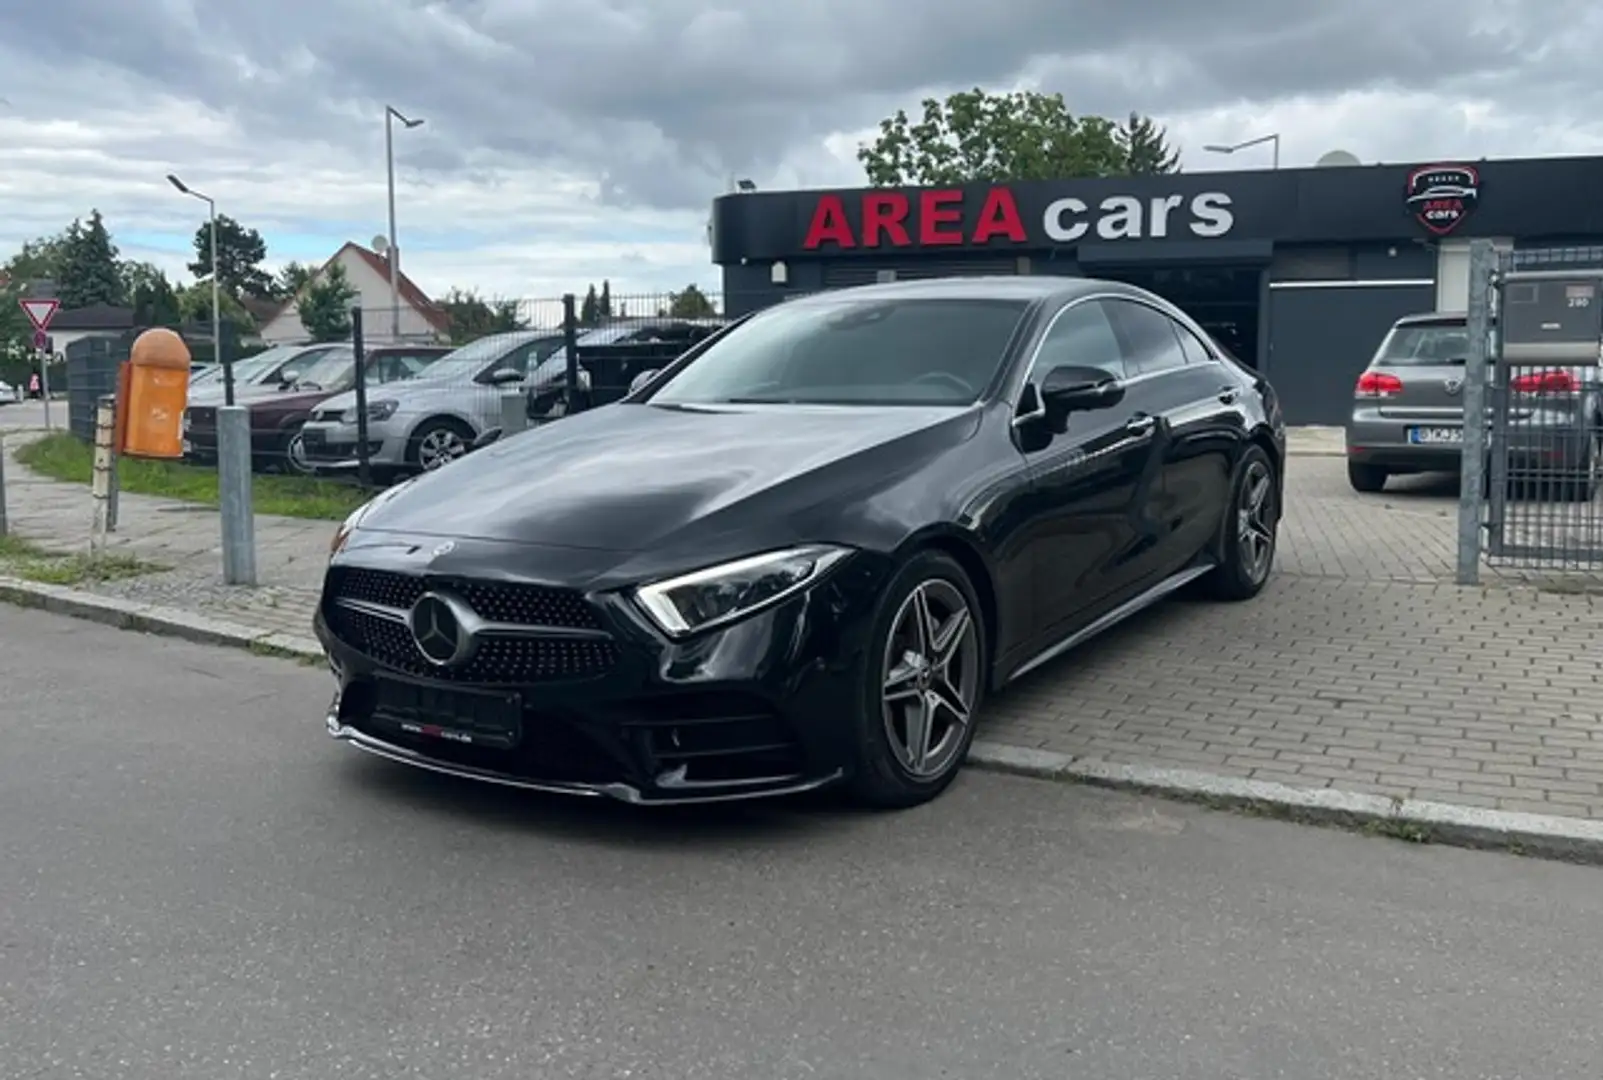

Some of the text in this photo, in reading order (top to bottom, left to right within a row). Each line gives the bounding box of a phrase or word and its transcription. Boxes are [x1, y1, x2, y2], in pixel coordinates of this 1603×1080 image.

[804, 188, 1234, 248] AREA cars
[1425, 210, 1459, 220] cars
